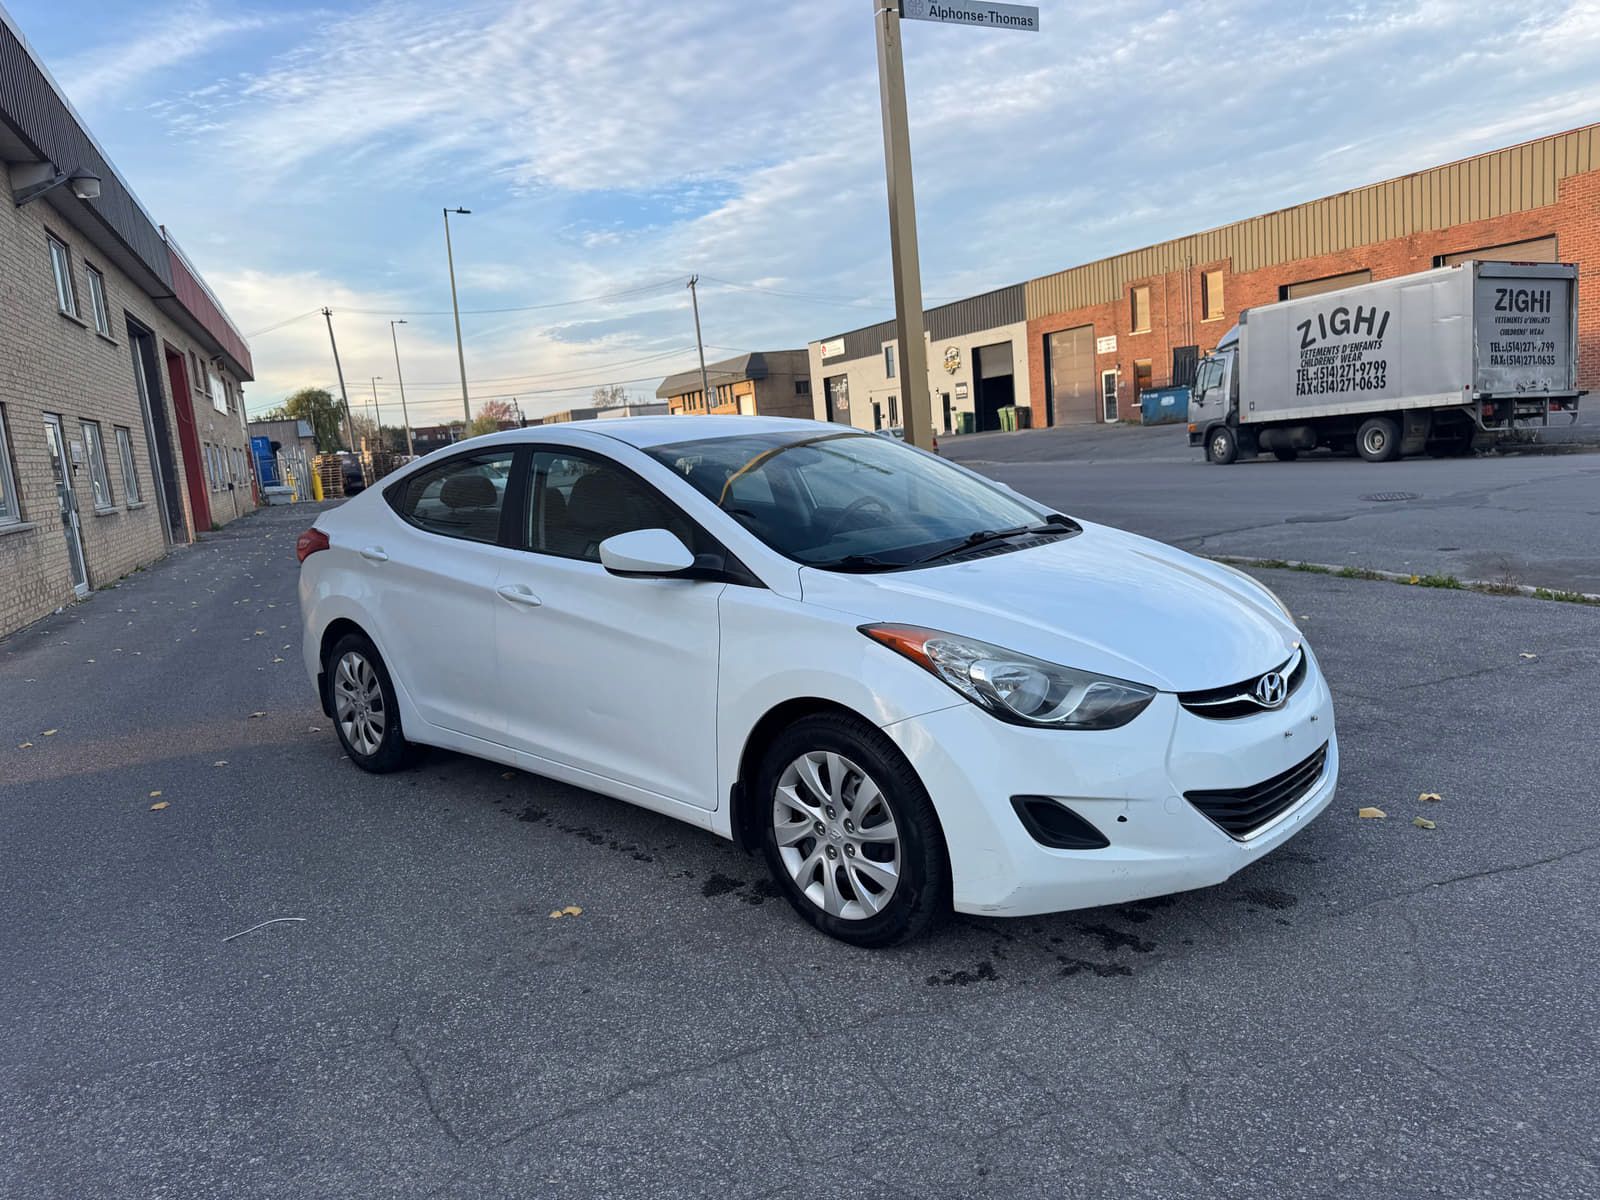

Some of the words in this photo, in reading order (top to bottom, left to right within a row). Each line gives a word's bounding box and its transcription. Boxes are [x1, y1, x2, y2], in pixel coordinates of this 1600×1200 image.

[929, 5, 1033, 27] Alphonse-Thomas
[1495, 288, 1551, 313] ZIGHI
[1296, 305, 1390, 349] ZIGHI
[1341, 340, 1383, 354] D'ENFANTS
[1341, 352, 1363, 364] WEAR
